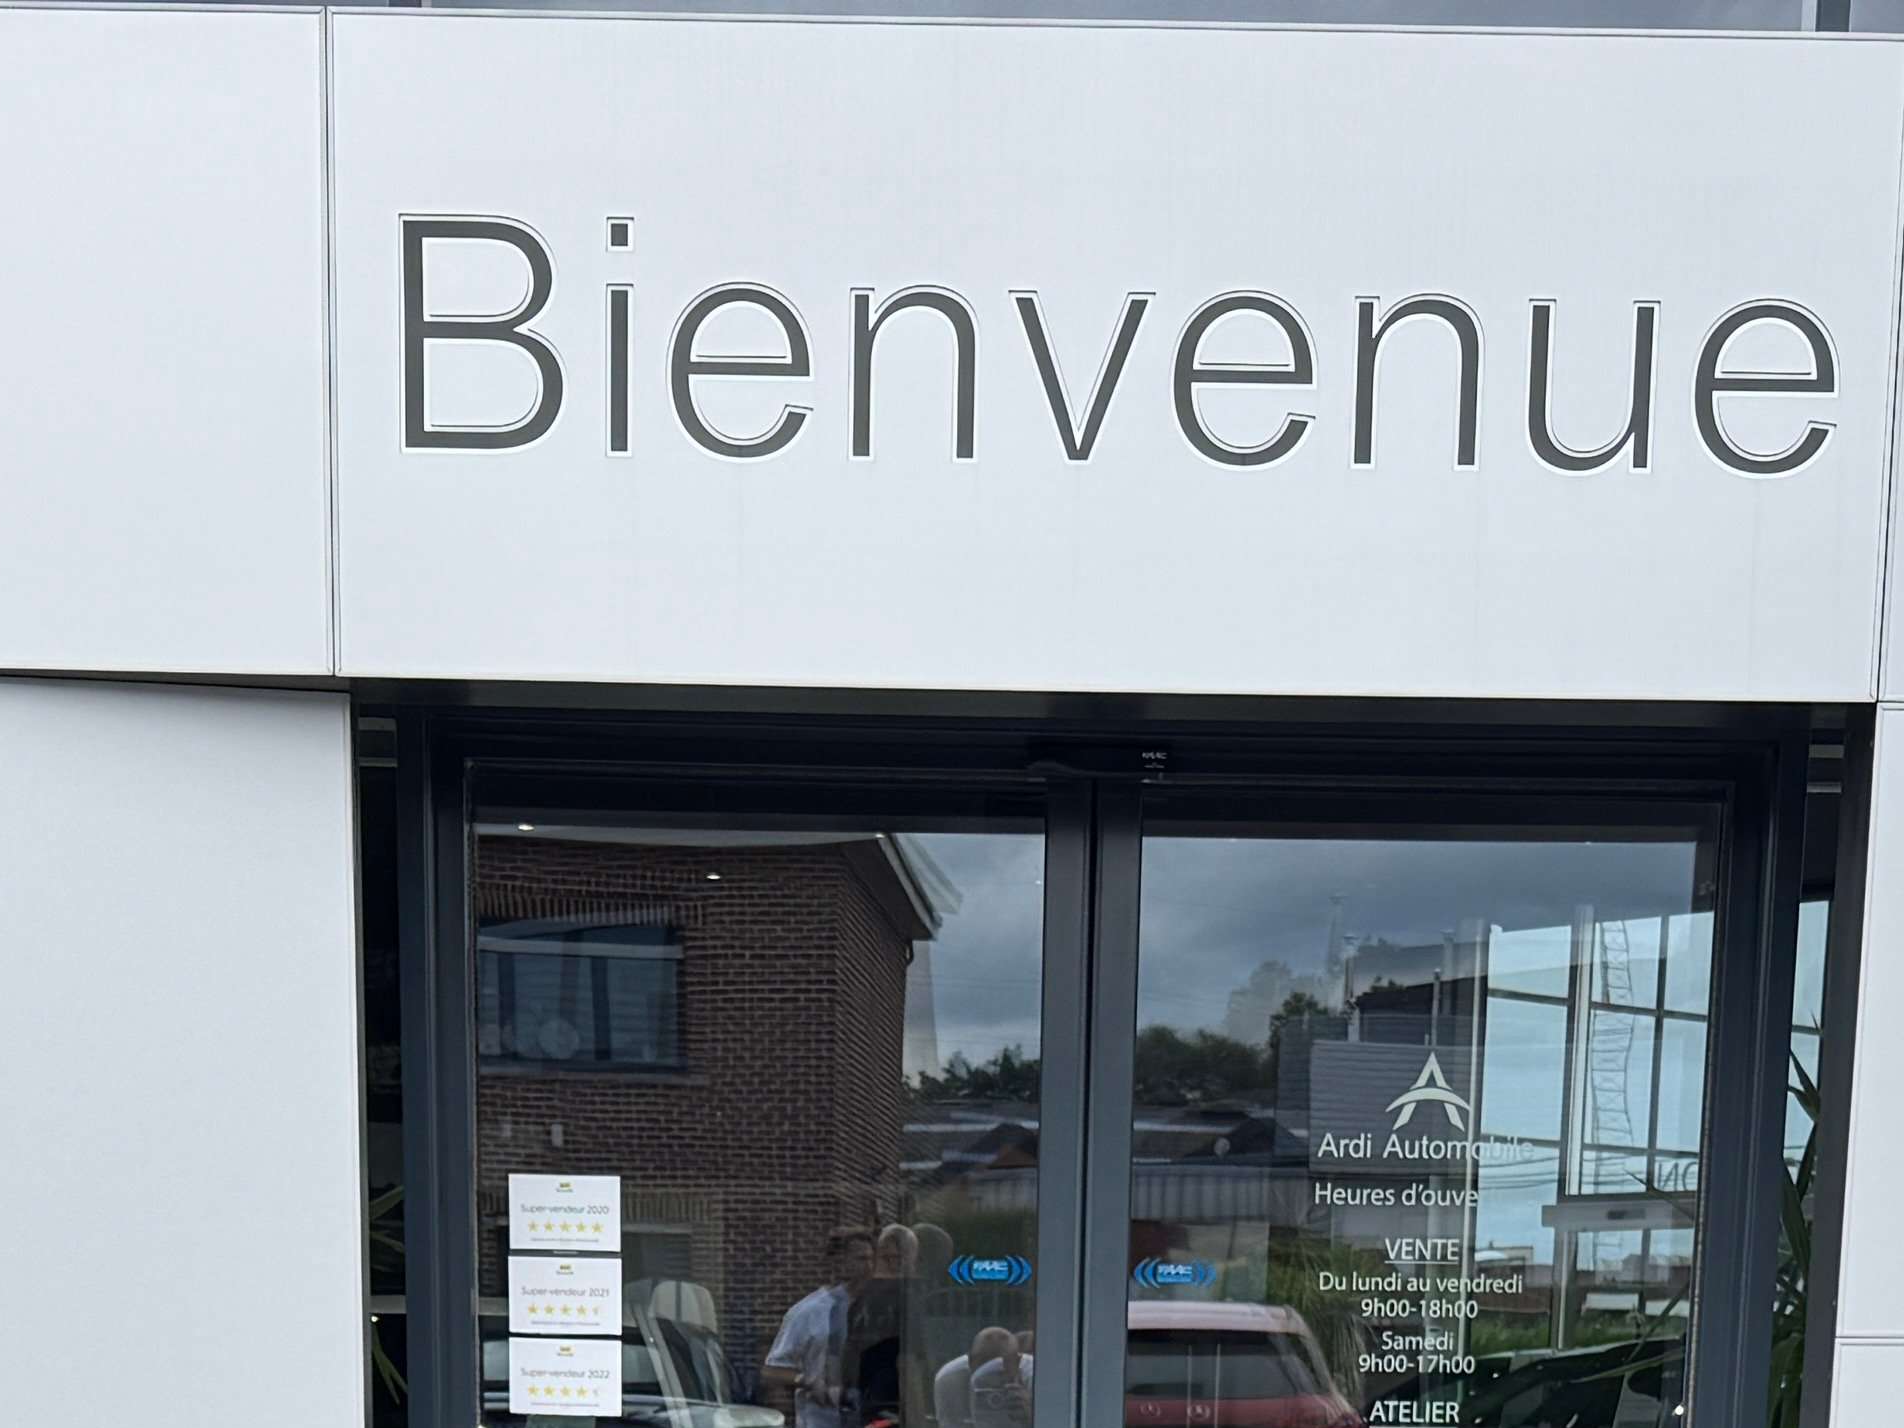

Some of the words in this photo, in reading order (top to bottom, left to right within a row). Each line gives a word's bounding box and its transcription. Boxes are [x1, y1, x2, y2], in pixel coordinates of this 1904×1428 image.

[398, 208, 1842, 476] Bienvenue
[1317, 1133, 1372, 1159] Ardi
[1383, 1135, 1535, 1161] Automobile
[1314, 1182, 1395, 1206] Heures
[1385, 1238, 1459, 1260] VENTE
[1319, 1273, 1347, 1291] Du
[1352, 1272, 1402, 1292] lundi
[1407, 1278, 1430, 1292] au
[1435, 1273, 1523, 1294] vendredi
[1360, 1299, 1478, 1319] 9h00-18h00
[1381, 1332, 1454, 1351] Samedi
[1358, 1354, 1475, 1375] 9h00-17h00
[1369, 1401, 1459, 1423] ATELIER
